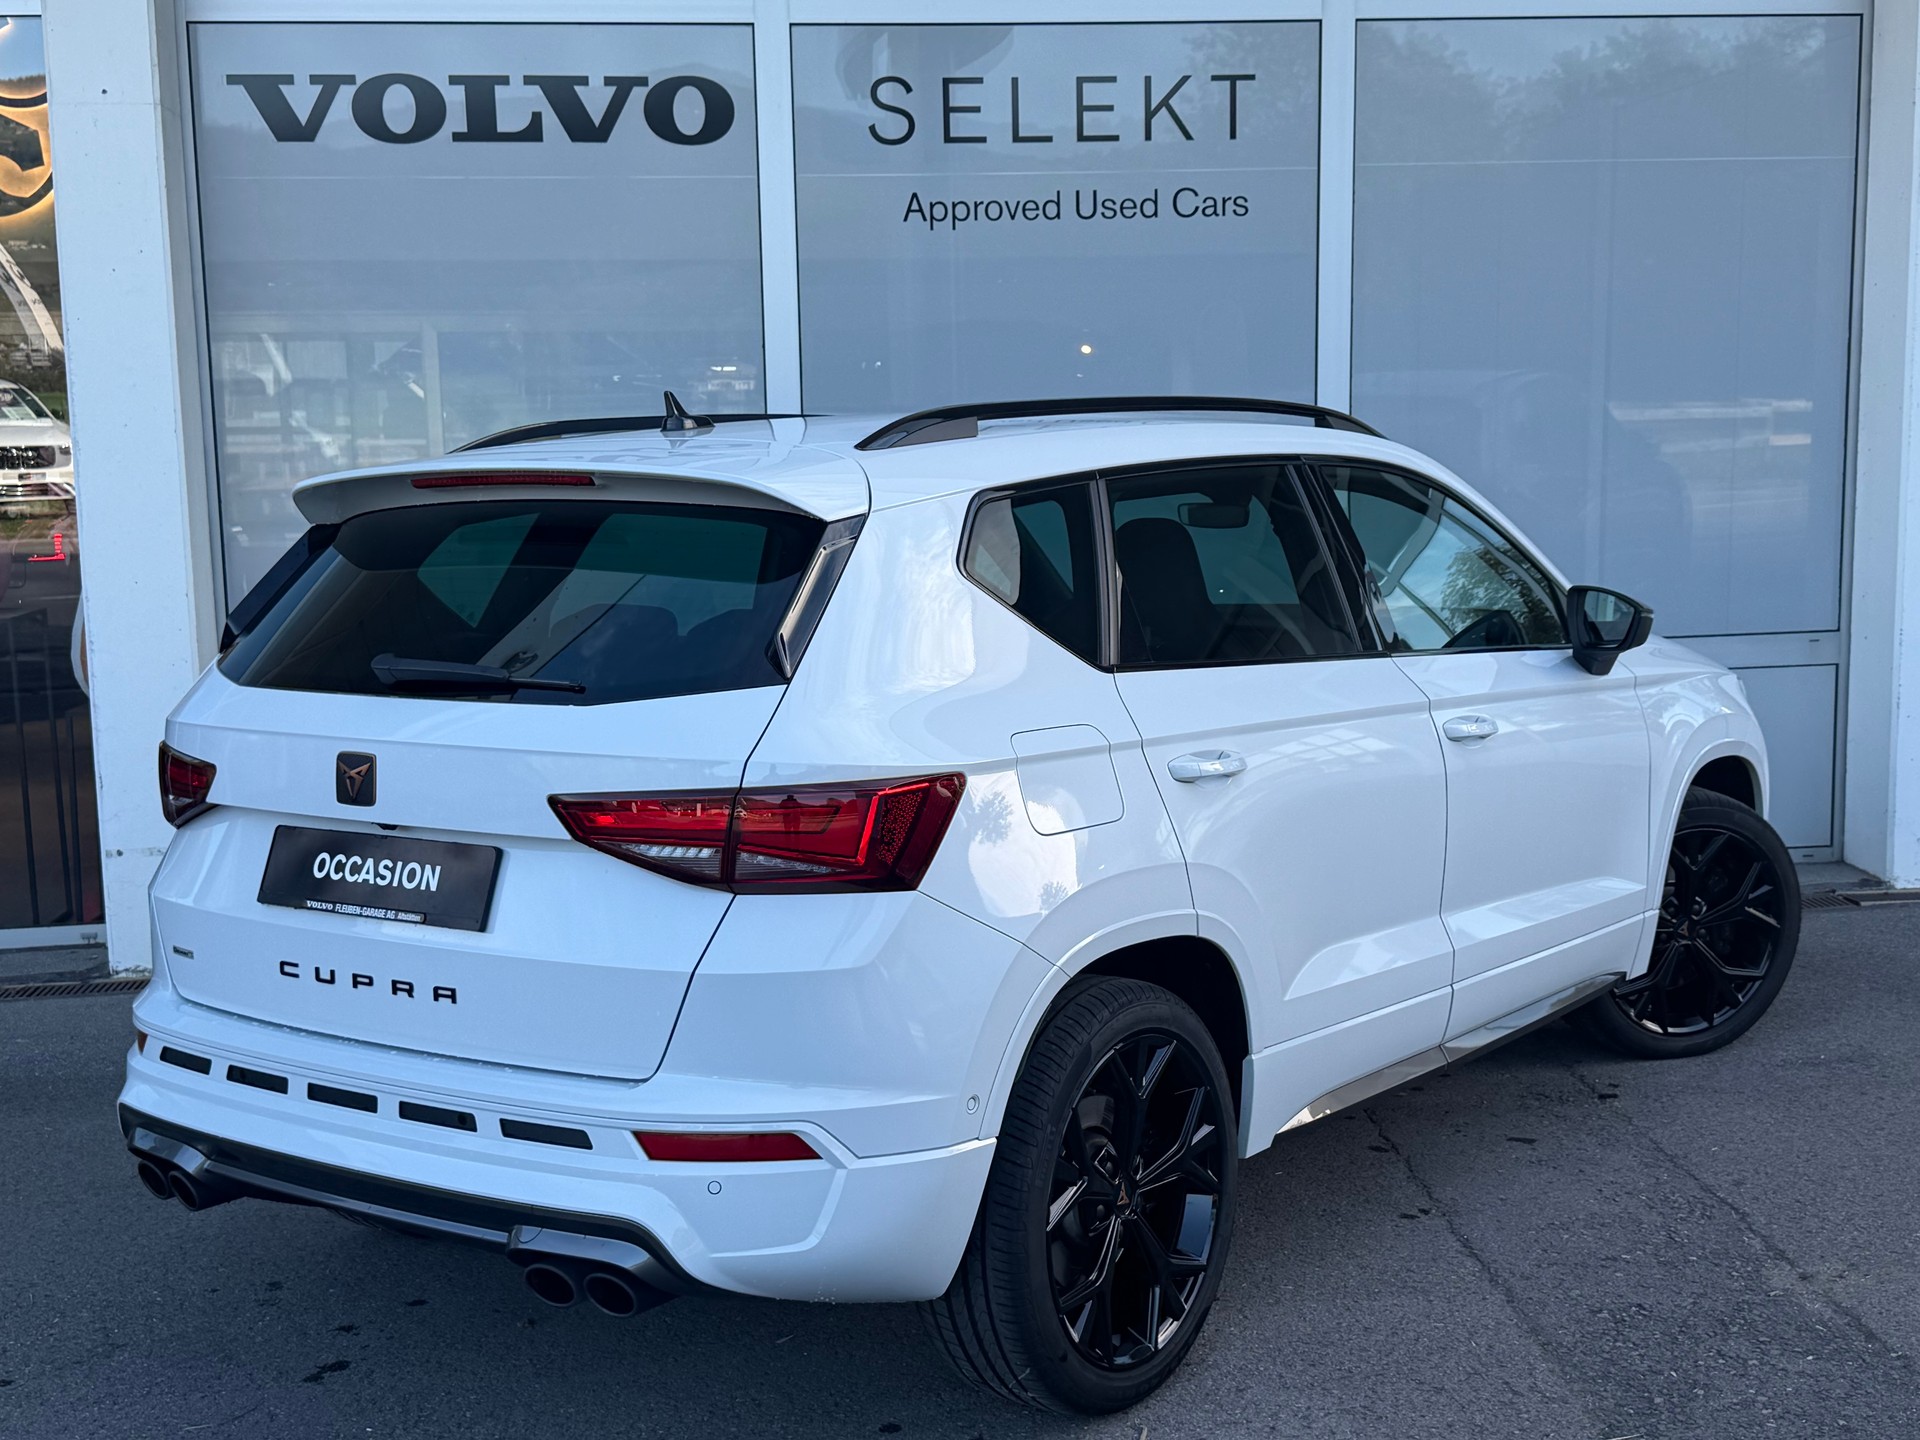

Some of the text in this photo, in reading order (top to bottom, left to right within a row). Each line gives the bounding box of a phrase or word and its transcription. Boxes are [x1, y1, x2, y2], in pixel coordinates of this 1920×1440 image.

[226, 73, 735, 145] VOLVO
[868, 74, 1256, 145] SELEKT
[903, 187, 1249, 230] Approved Used Cars
[313, 852, 441, 891] OCCASION
[306, 900, 333, 910] VOLVO
[386, 910, 396, 920] AG
[279, 960, 457, 1004] CUPRA
